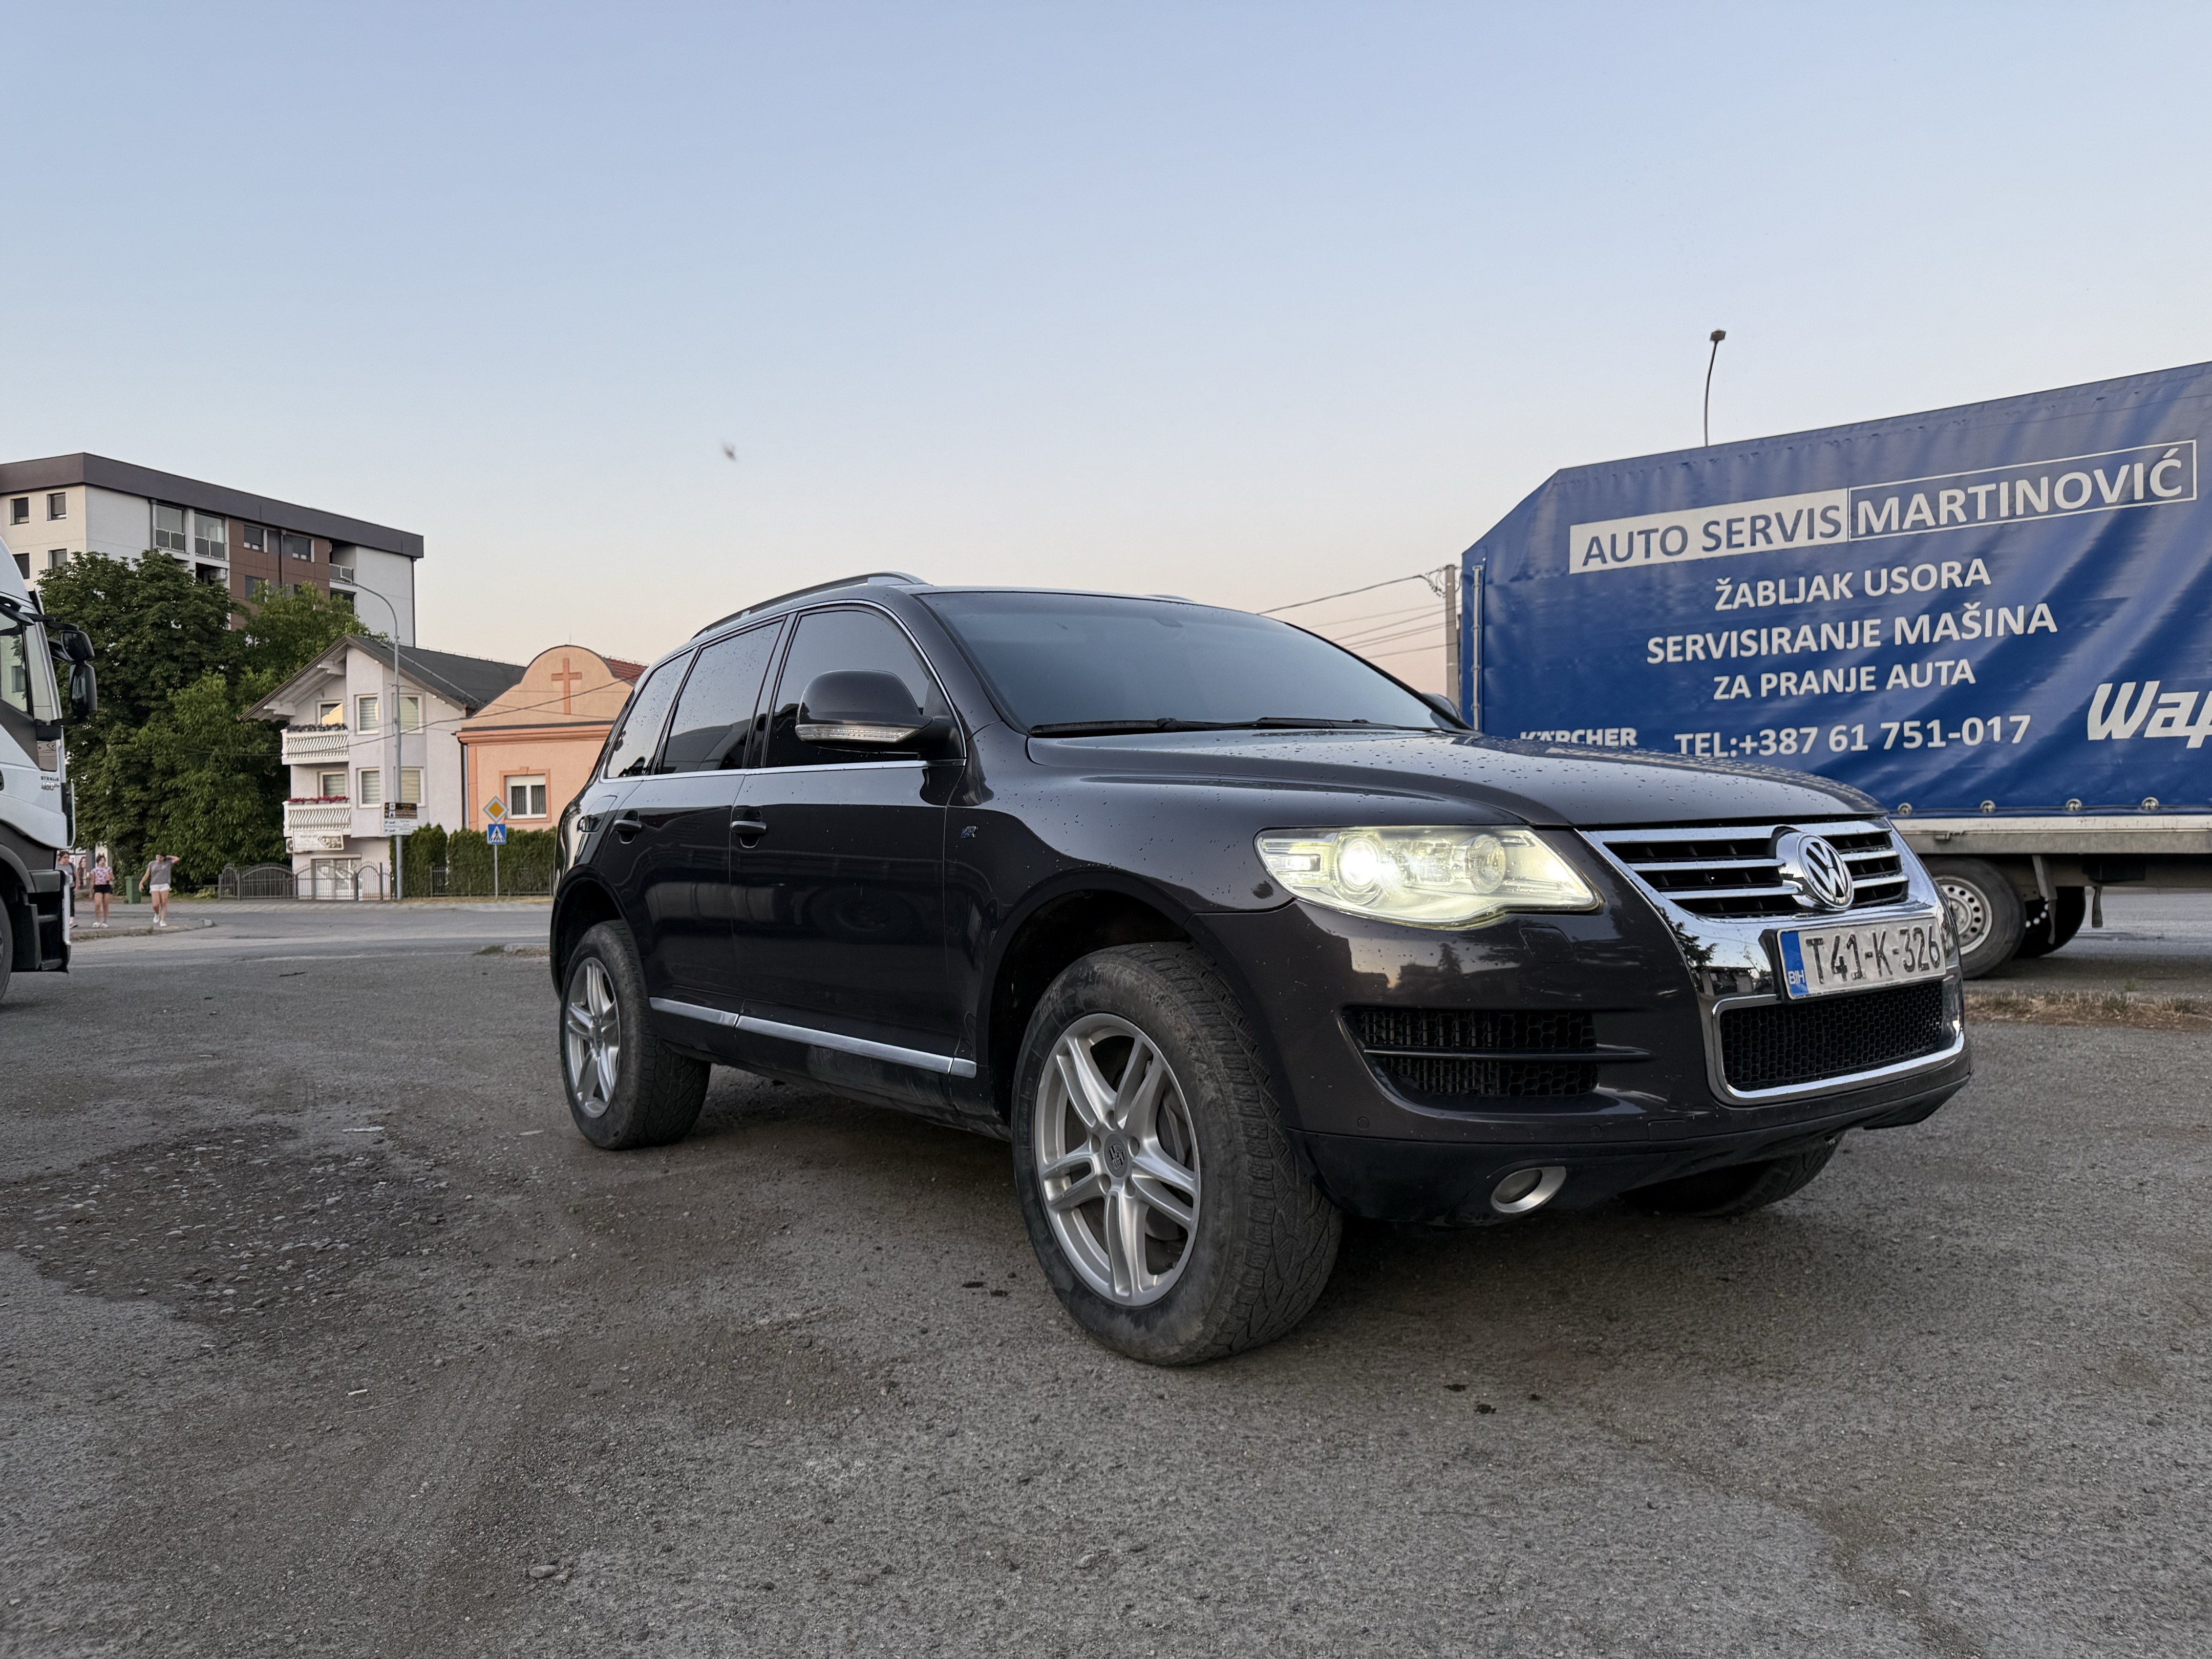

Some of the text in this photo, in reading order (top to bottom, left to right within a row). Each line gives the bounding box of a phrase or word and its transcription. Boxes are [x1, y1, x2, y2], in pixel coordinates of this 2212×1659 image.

[1582, 448, 2183, 567] AUTO SERVIS MARTINOVIĆ
[1714, 559, 1991, 611] ŽABLJAK USORA
[1646, 601, 2058, 664] SERVISIRANJE MAŠINA
[1713, 658, 1976, 700] ZA PRANJE AUTA
[1673, 714, 2031, 757] TEL:+387 61 751-017
[1788, 970, 1805, 985] BIH
[1804, 924, 1941, 985] T41-K-326
